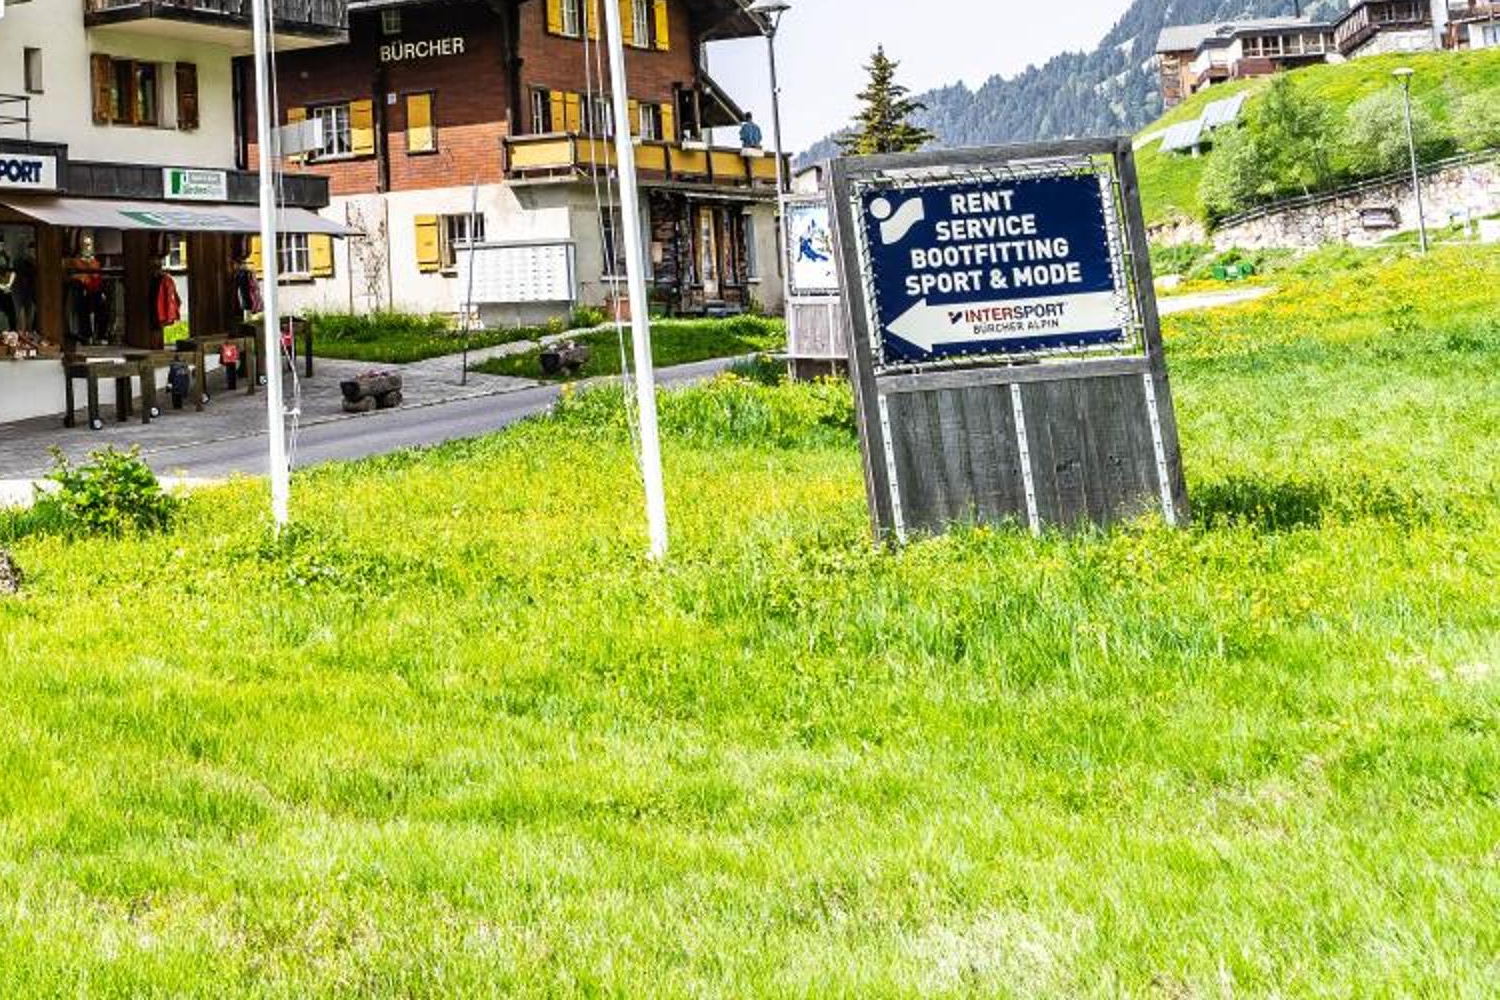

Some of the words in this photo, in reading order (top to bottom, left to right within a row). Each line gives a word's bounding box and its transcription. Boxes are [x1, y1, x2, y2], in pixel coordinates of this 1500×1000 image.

[380, 37, 465, 62] BÜRCHER
[950, 189, 1014, 215] RENT
[935, 213, 1037, 242] SERVICE
[910, 237, 1069, 269] BOOTFITTING
[905, 269, 983, 296] SPORT
[989, 268, 1008, 289] &
[1012, 261, 1082, 288] MODE
[965, 302, 1064, 323] INTERSPORT
[1027, 318, 1059, 330] ALPIN
